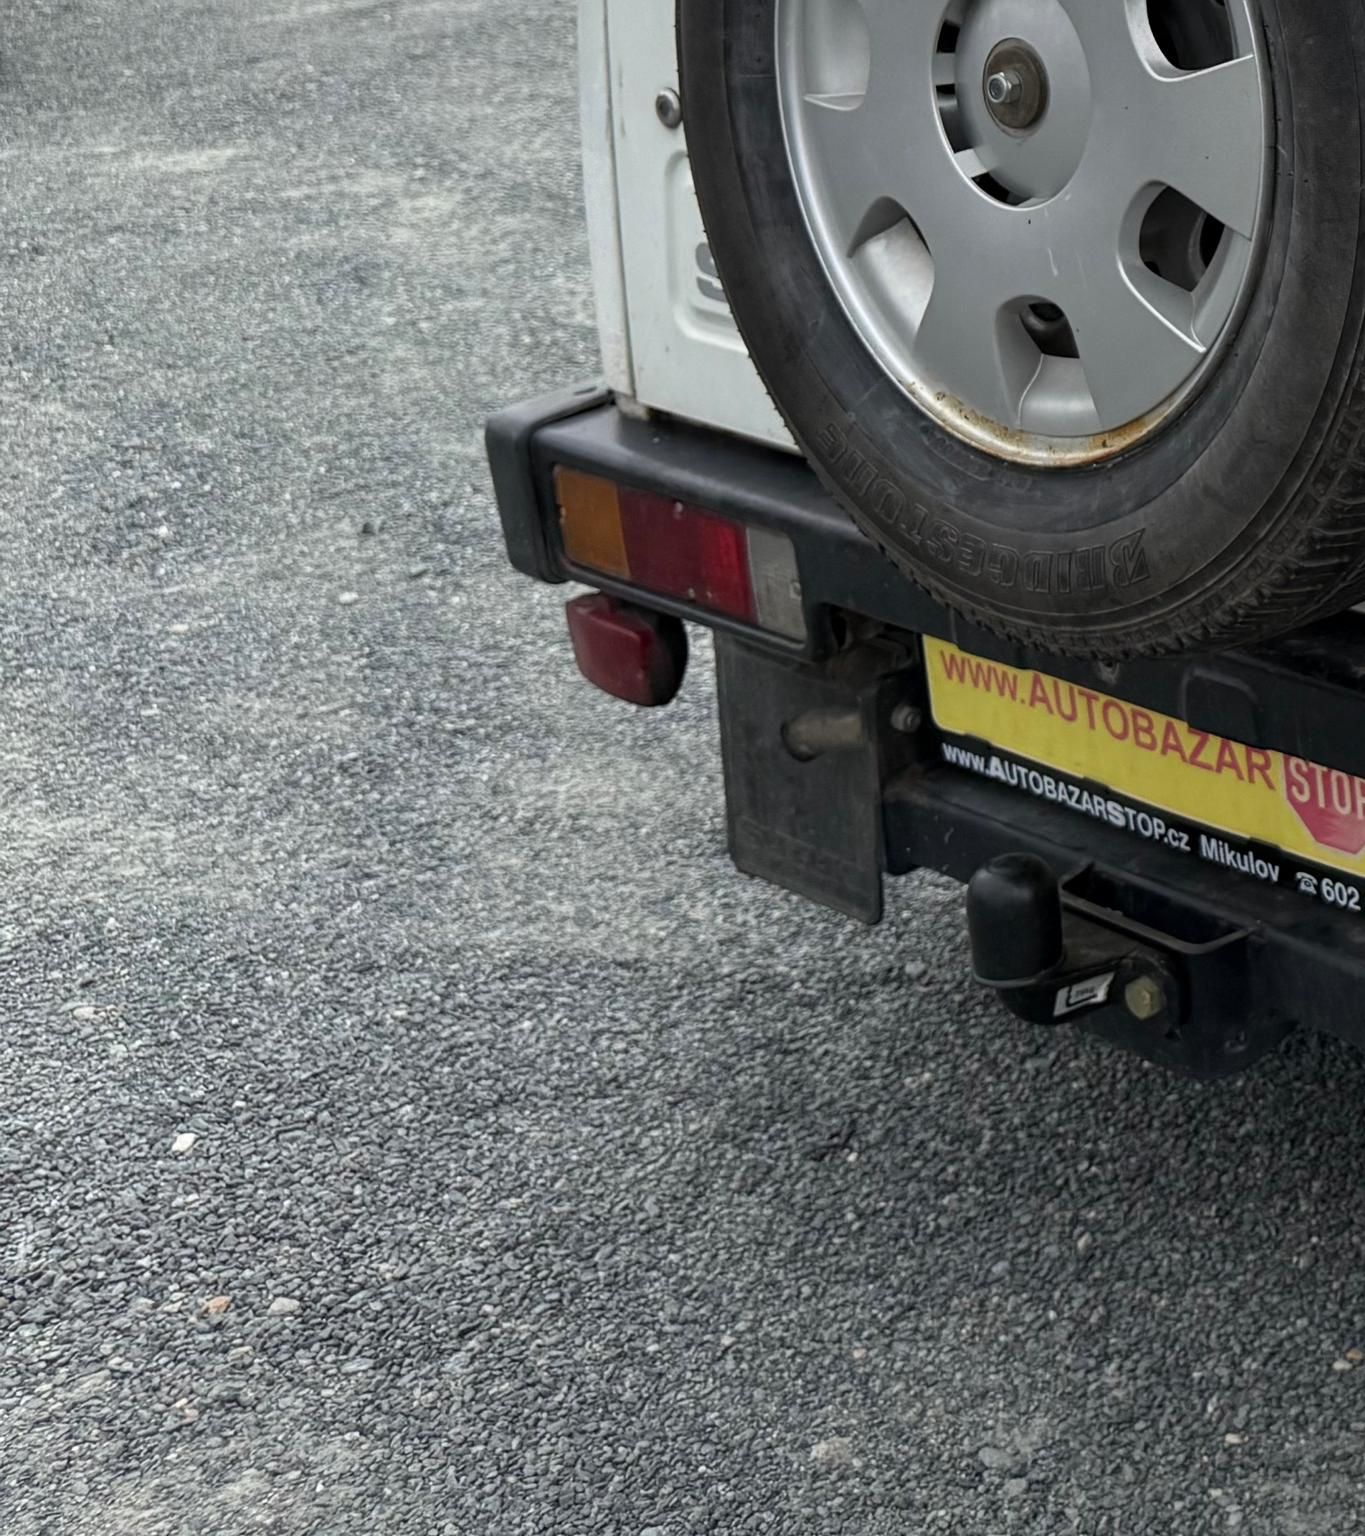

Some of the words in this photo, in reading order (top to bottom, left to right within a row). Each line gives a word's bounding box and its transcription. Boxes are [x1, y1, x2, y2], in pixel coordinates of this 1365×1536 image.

[814, 422, 1150, 594] BRIDGESTONE
[1200, 834, 1280, 882] Mikulov
[1321, 877, 1362, 911] 602
